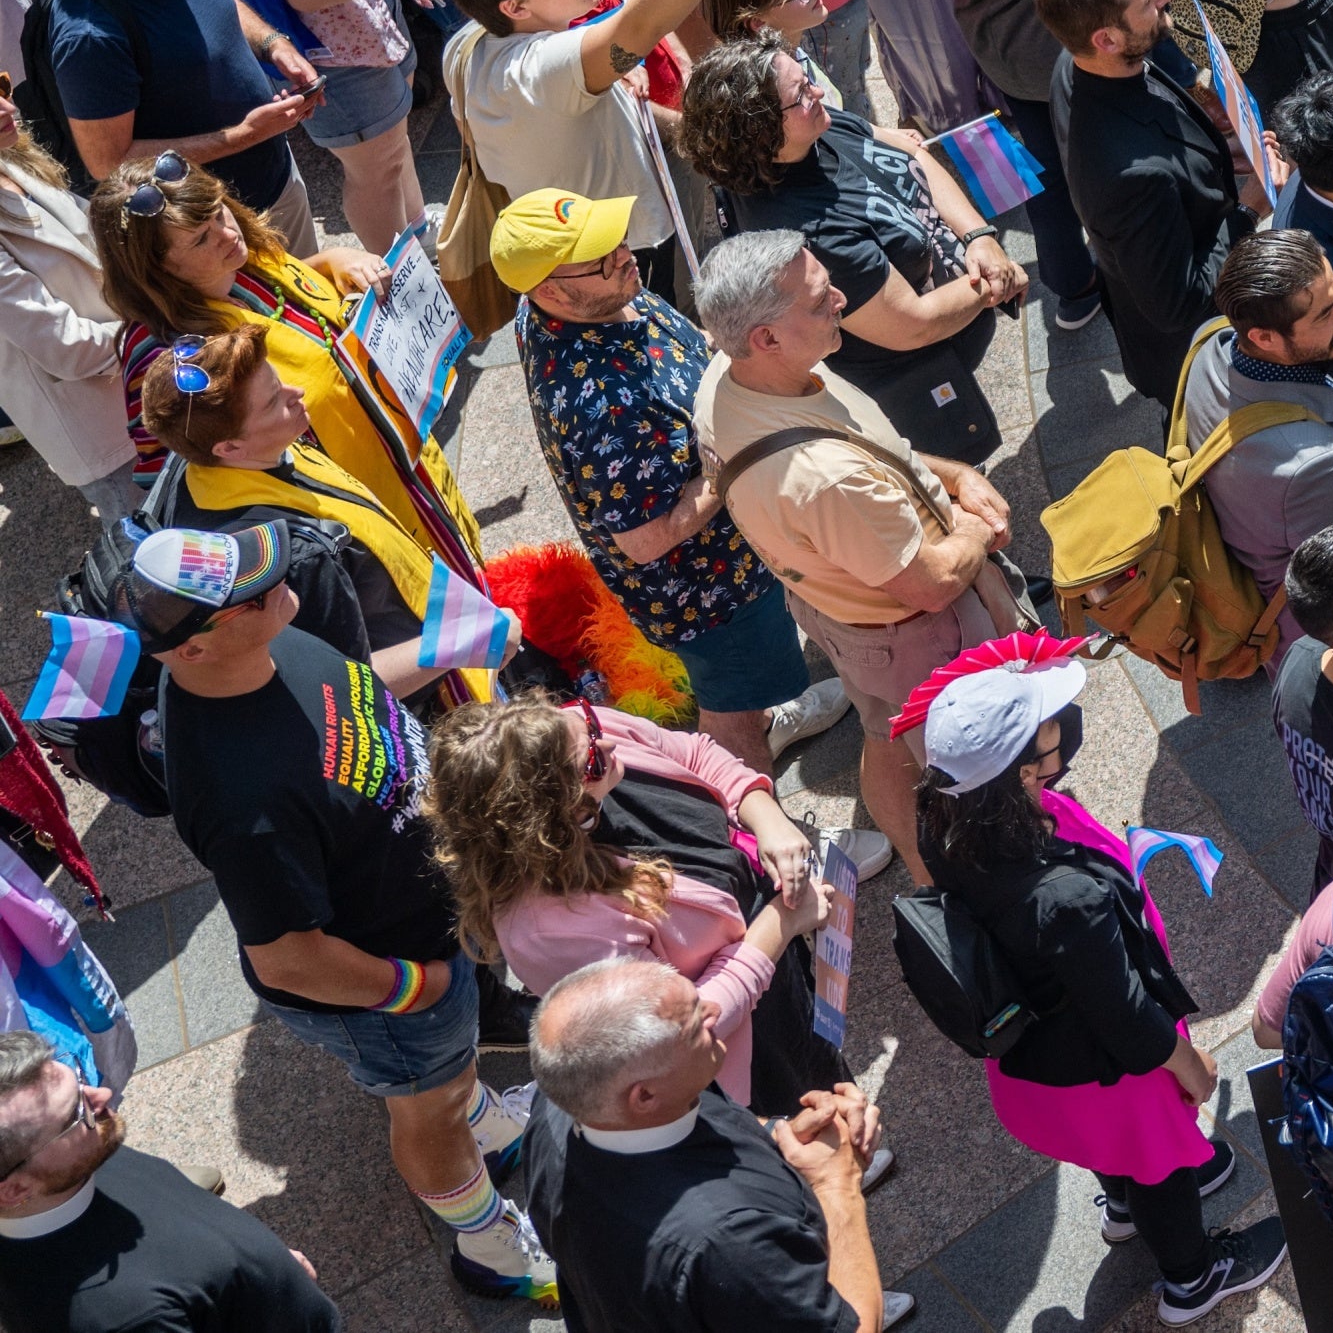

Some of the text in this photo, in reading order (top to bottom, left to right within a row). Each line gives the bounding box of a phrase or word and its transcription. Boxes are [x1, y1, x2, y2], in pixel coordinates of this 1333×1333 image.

[441, 325, 470, 372] EQUALITY
[360, 662, 376, 705] HEALTH
[322, 683, 339, 780] HUMAN RIGHTS
[338, 717, 353, 787] EQUALITY
[345, 661, 371, 793] AFFORDABLE HOUSING
[365, 741, 387, 799] GLOBAL
[825, 936, 853, 975] TRANS
